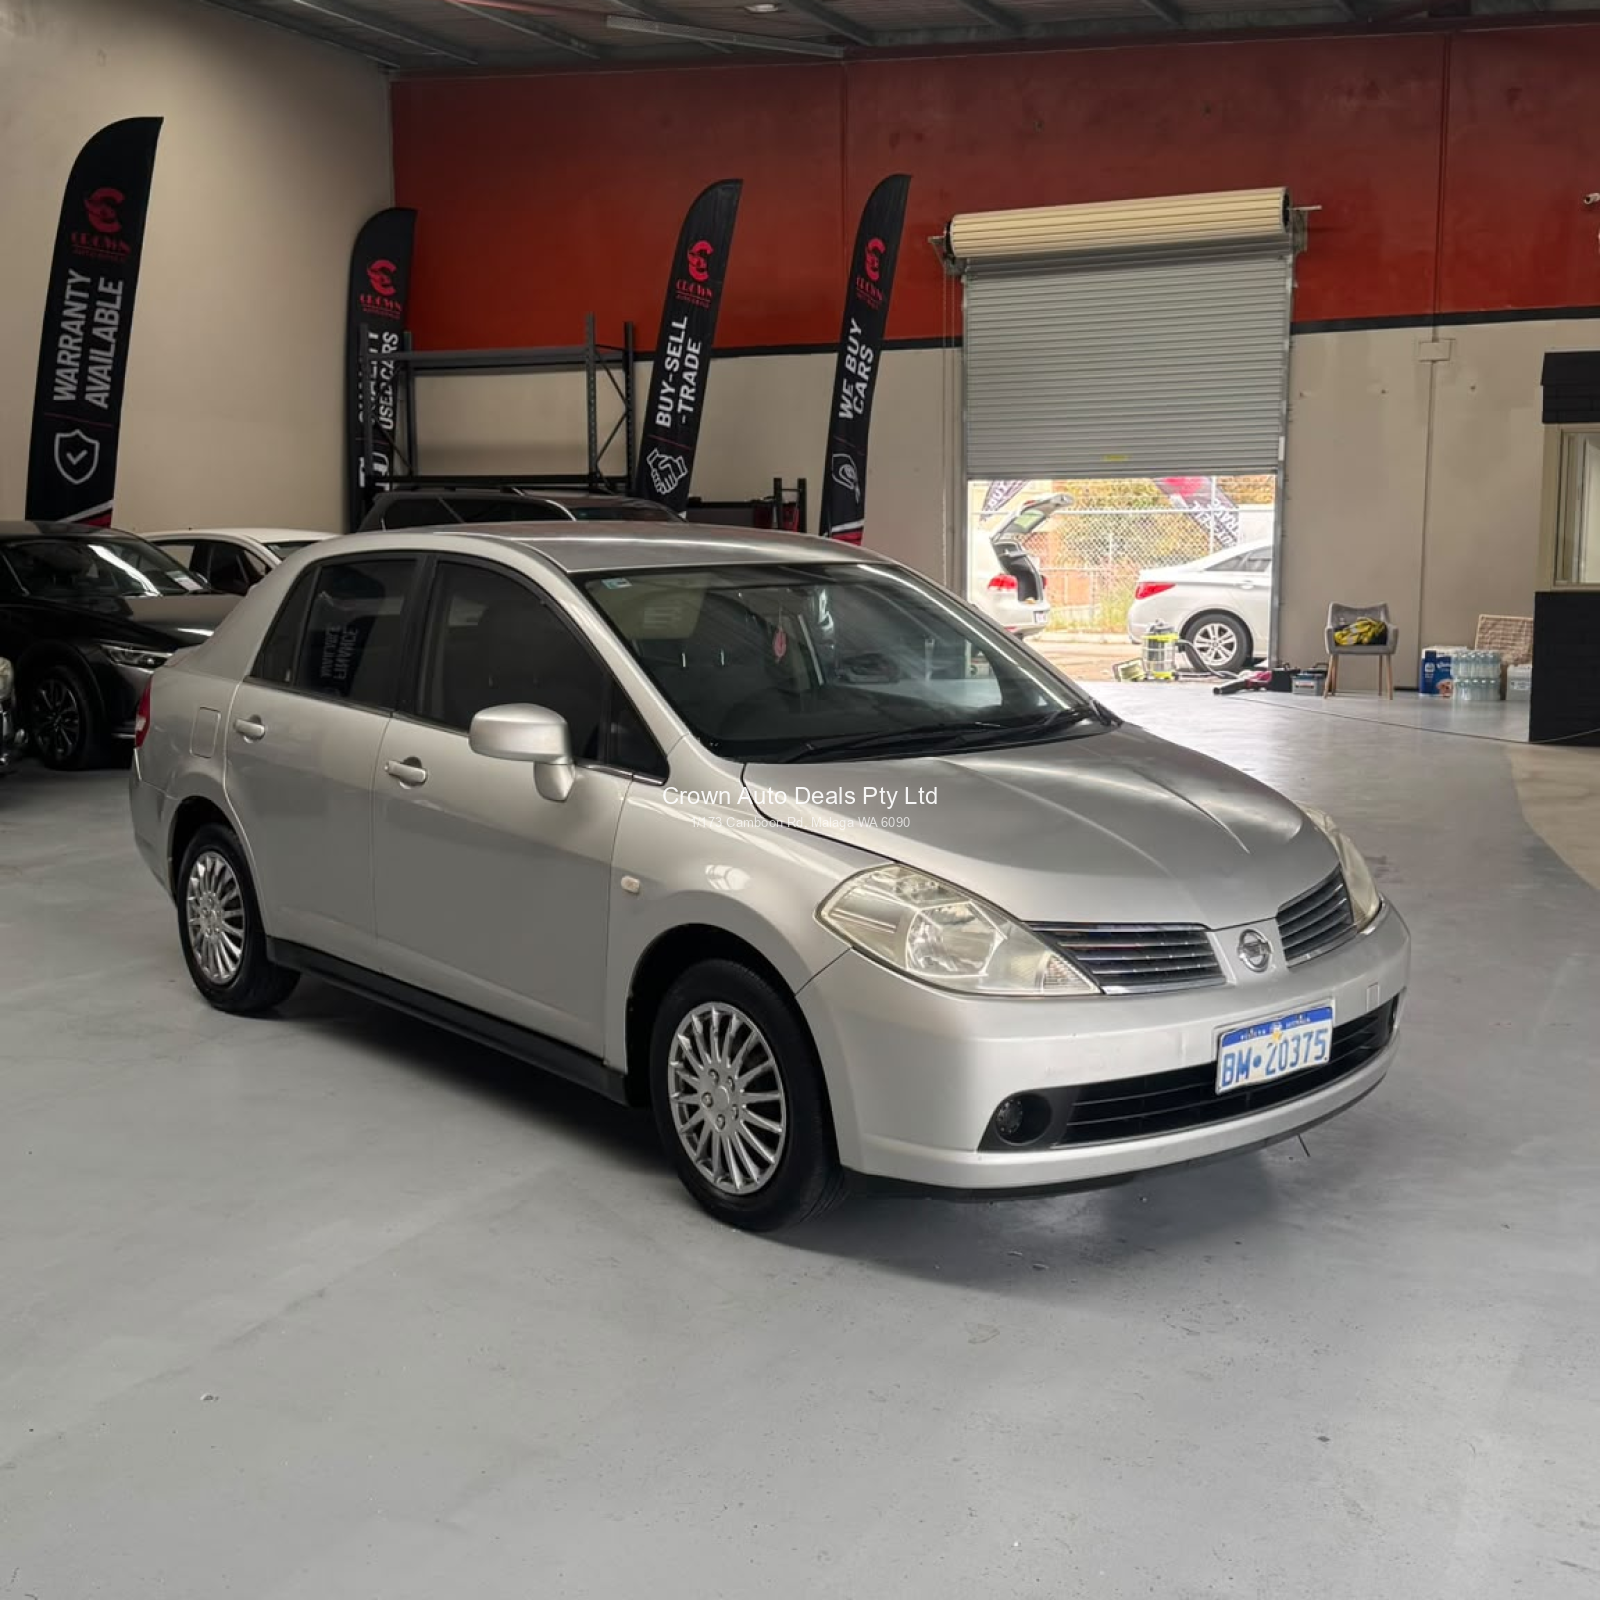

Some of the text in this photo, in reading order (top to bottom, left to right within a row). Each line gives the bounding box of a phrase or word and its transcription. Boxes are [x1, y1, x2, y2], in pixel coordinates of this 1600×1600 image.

[53, 268, 91, 401] WARRANTY
[84, 277, 123, 410] AVAILABLE
[655, 316, 688, 428] BUY-SELL
[838, 317, 862, 419] WE BUY
[853, 344, 874, 415] CARS
